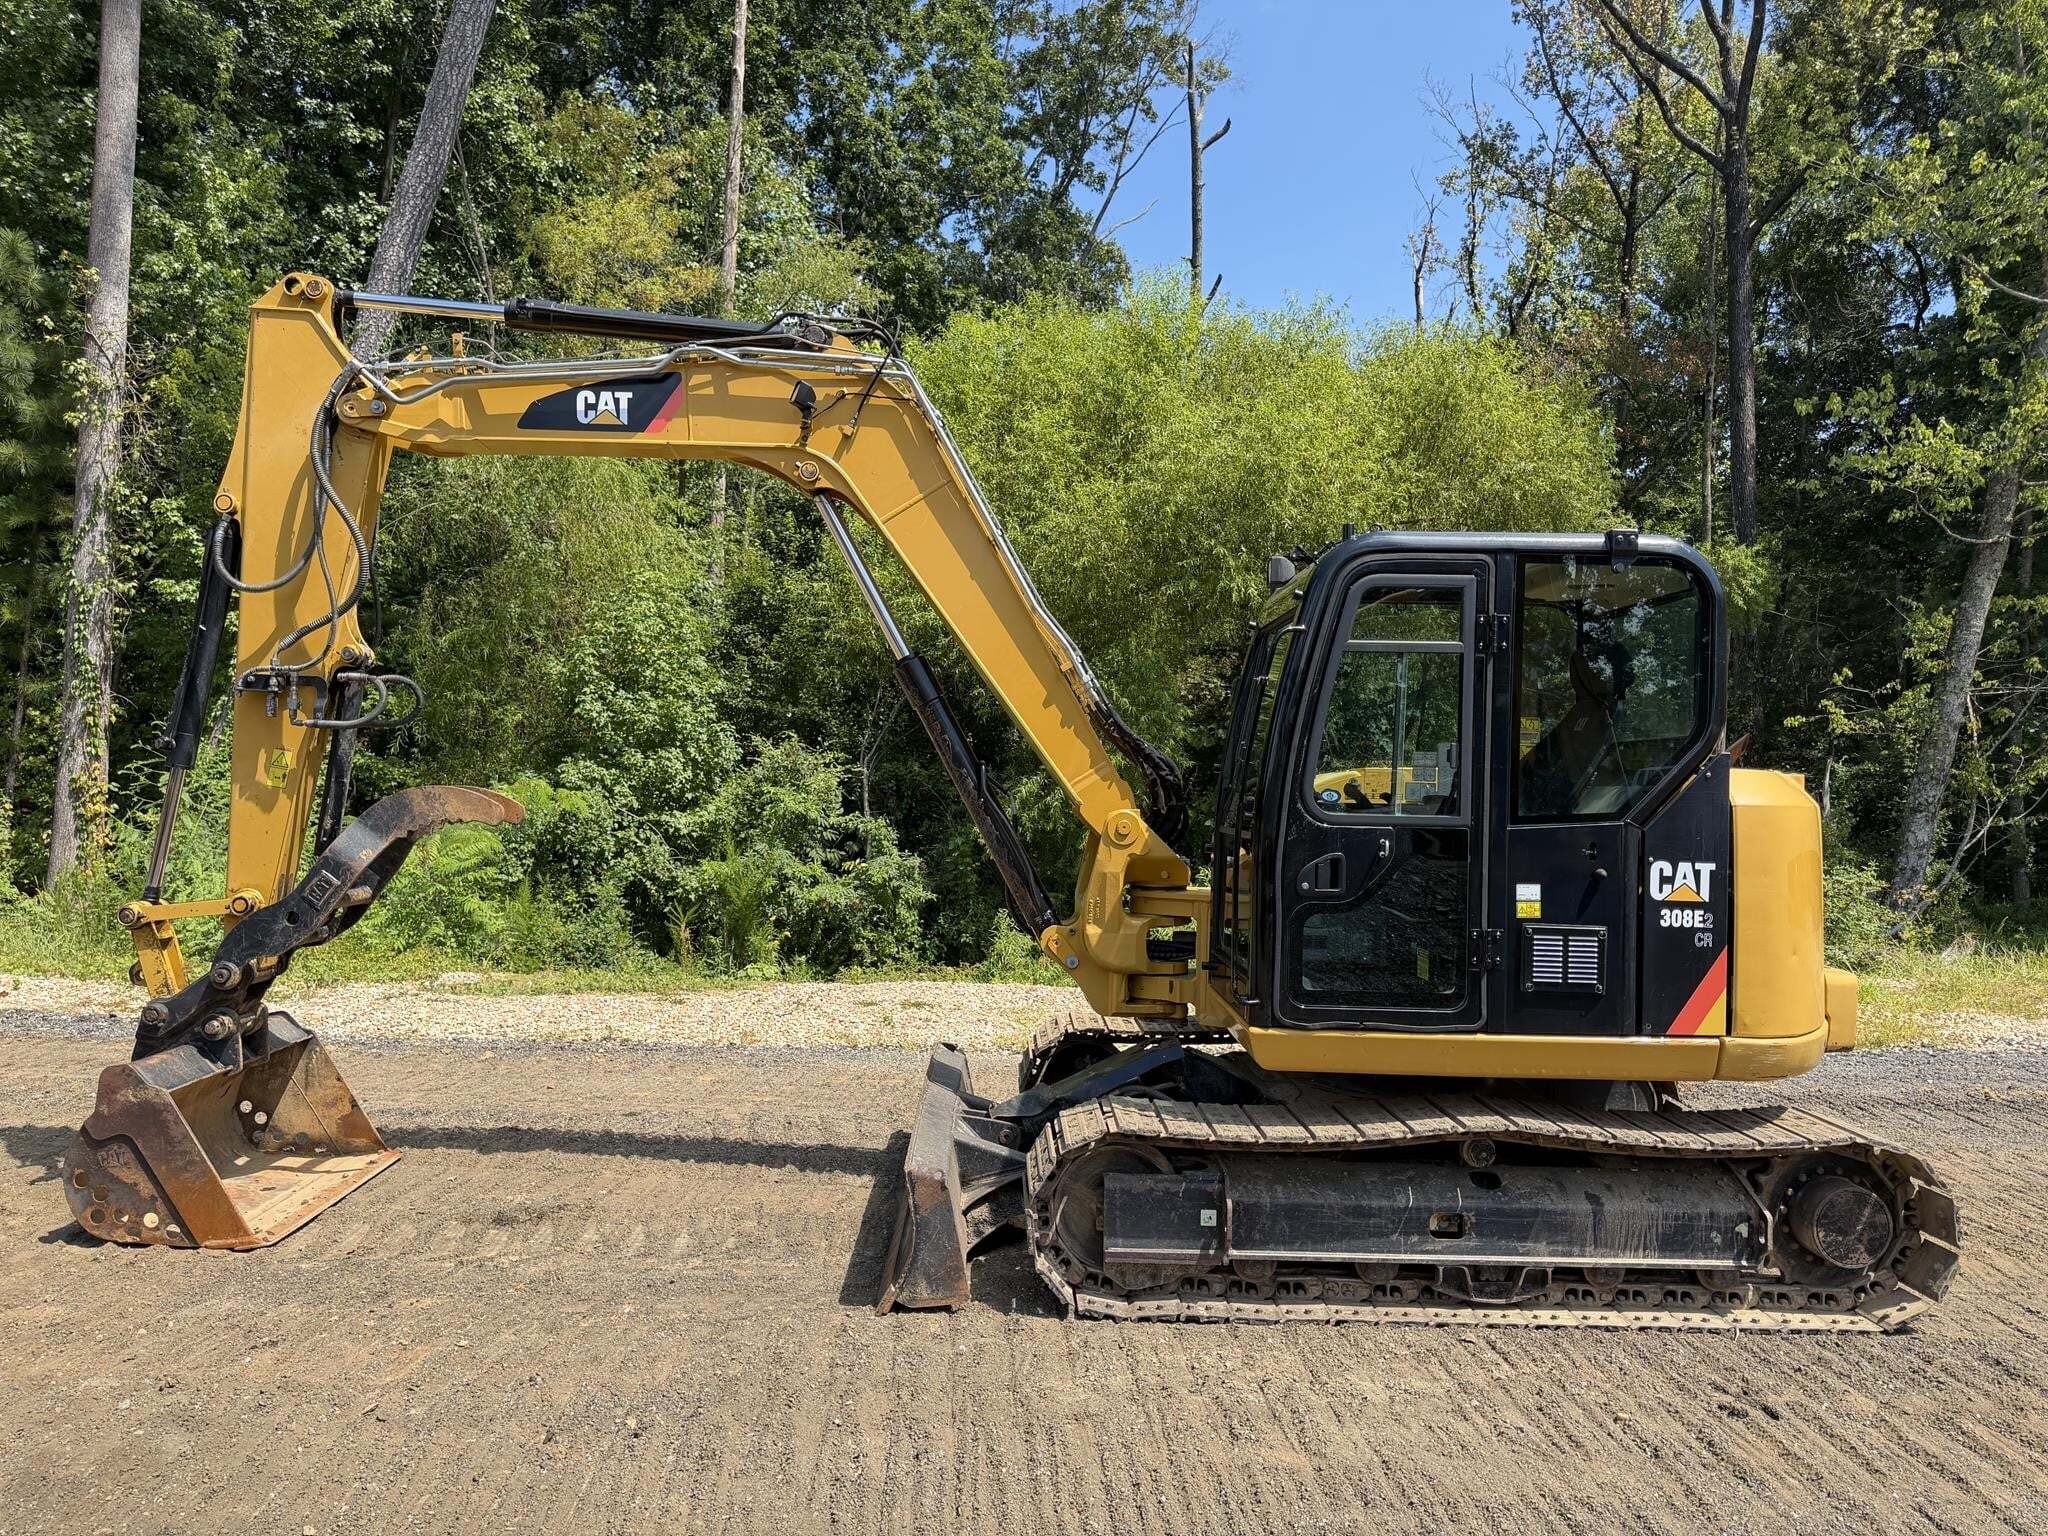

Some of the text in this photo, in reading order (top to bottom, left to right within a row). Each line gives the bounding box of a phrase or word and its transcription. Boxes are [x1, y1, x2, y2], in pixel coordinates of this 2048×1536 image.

[576, 390, 633, 425] CAT
[1650, 860, 1716, 902] CAT
[1695, 933, 1713, 948] CR
